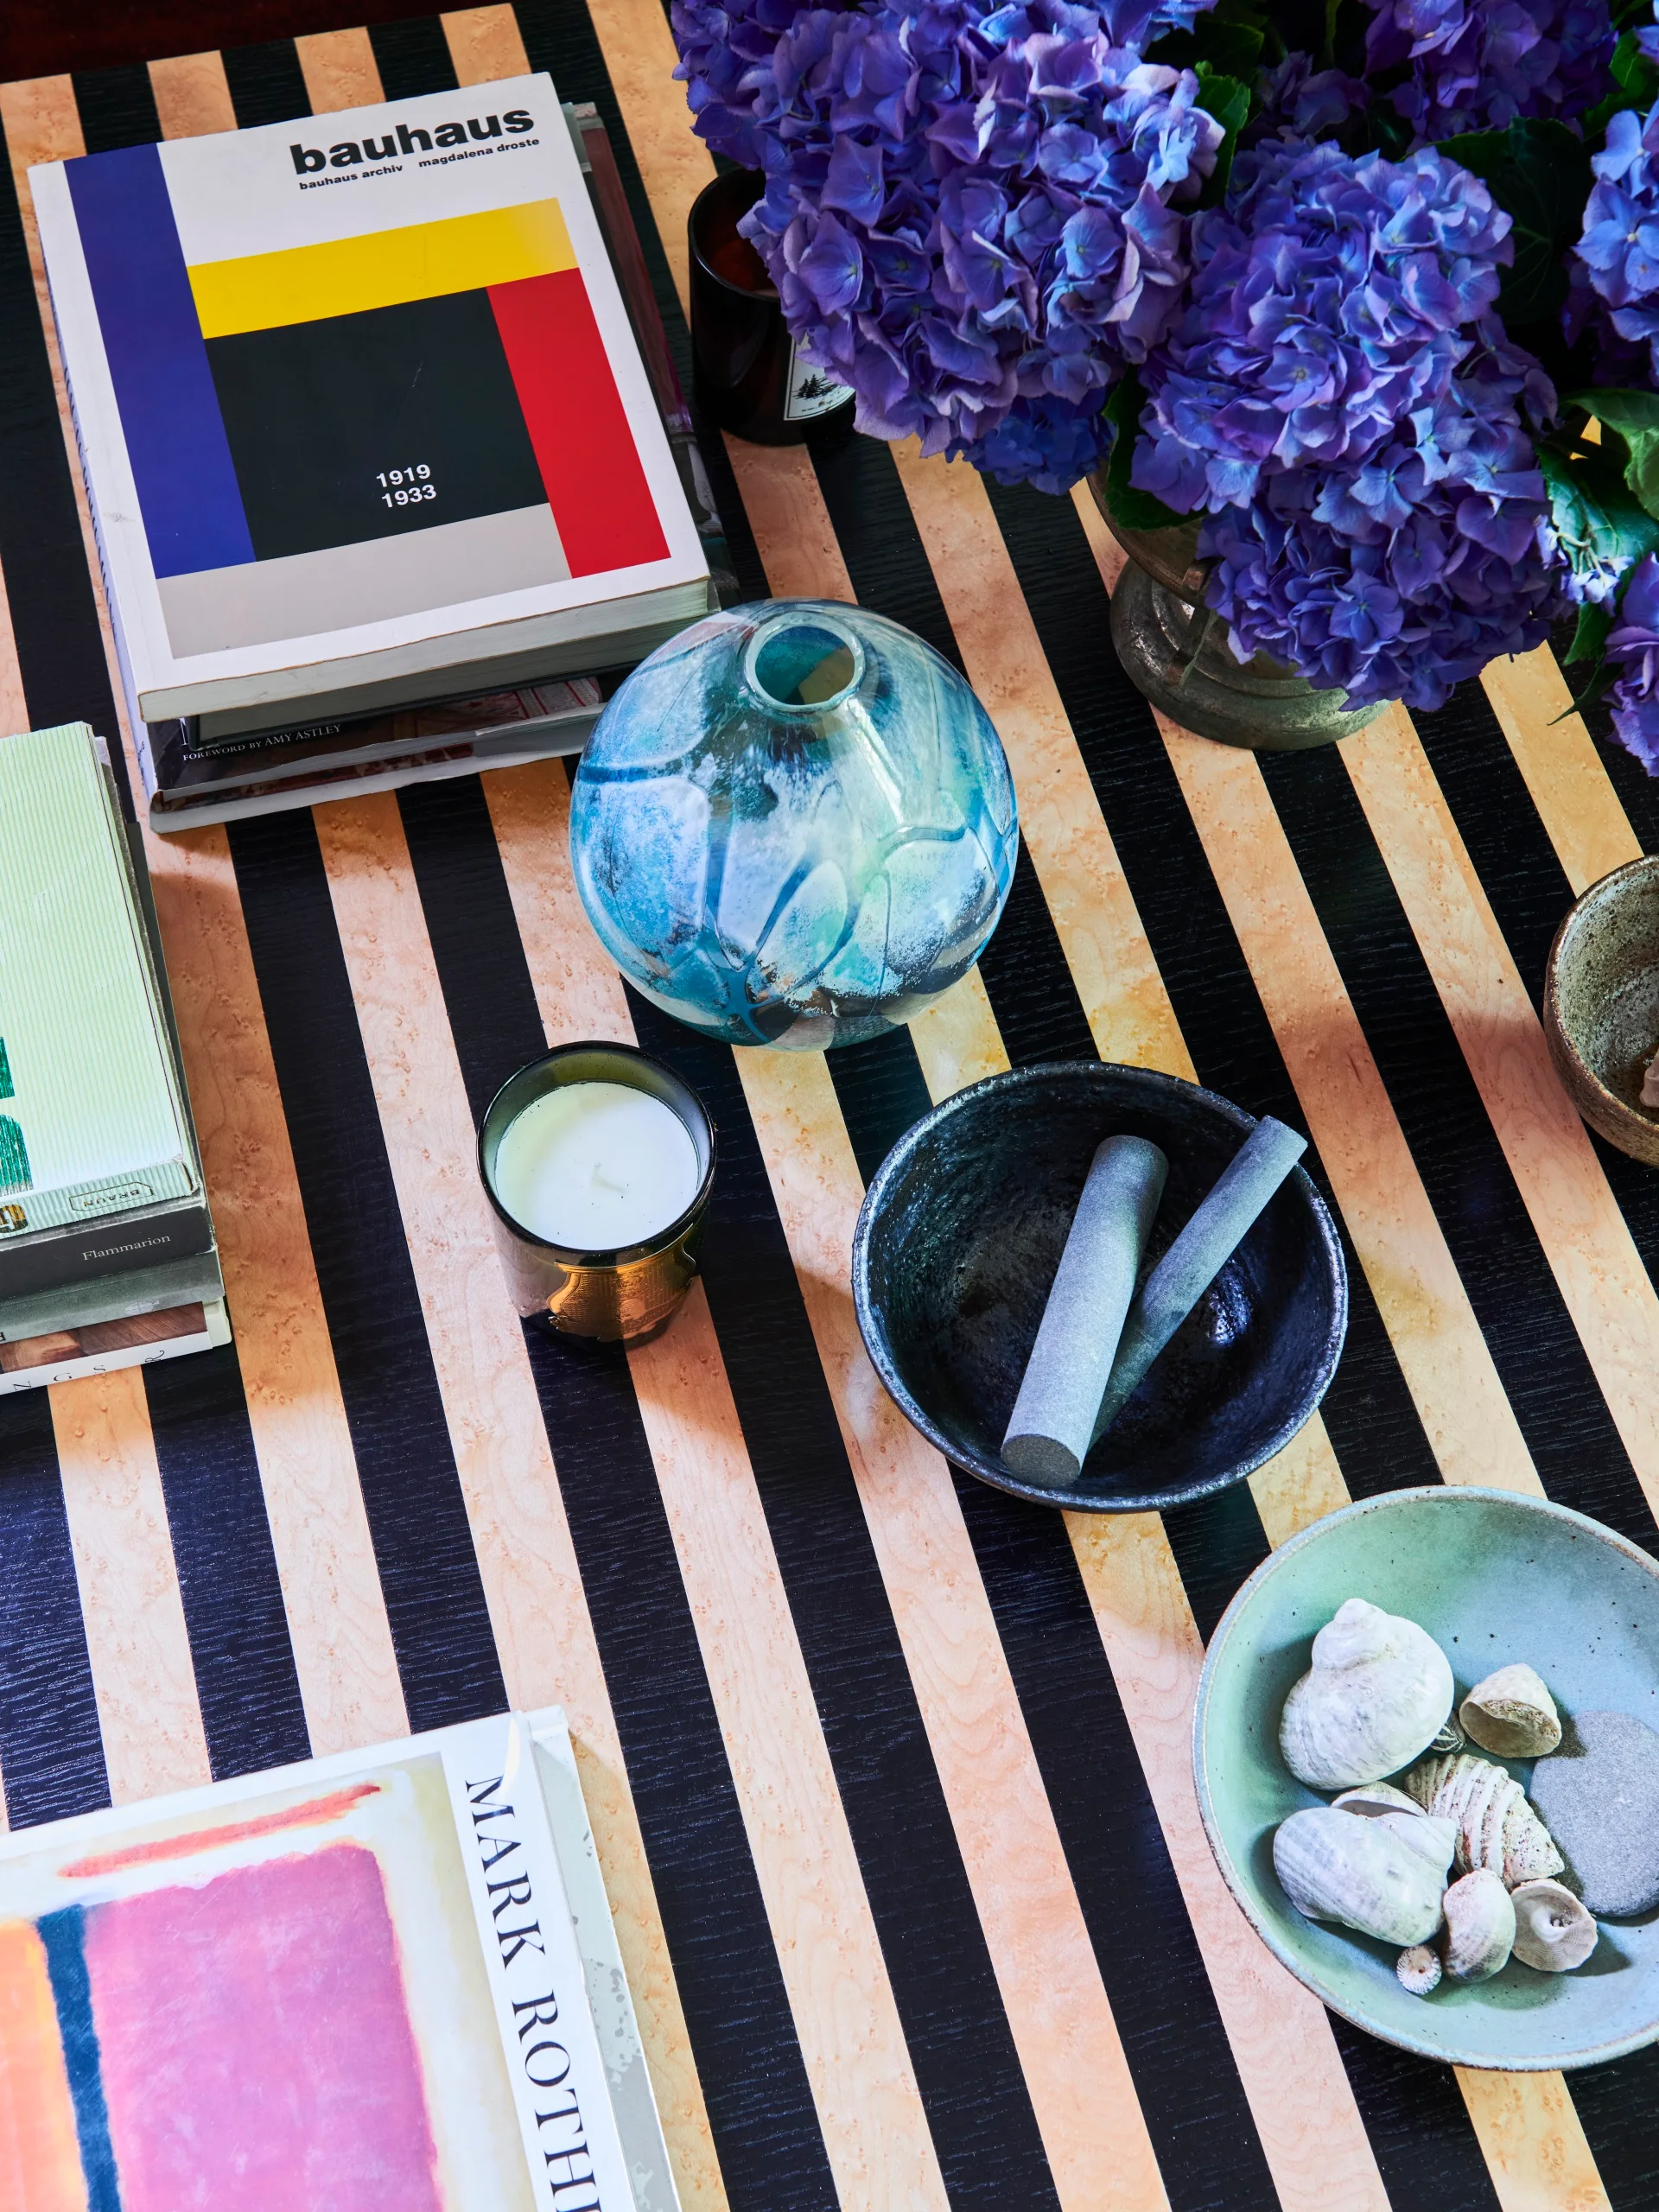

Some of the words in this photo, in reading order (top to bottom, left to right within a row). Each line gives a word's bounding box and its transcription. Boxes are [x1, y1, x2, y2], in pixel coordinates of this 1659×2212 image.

[289, 110, 534, 175] bauhaus
[299, 172, 358, 190] bauhaus
[361, 163, 404, 179] archiv
[418, 145, 493, 168] magdalena
[497, 138, 540, 153] droste
[376, 464, 431, 487] 1919
[381, 484, 437, 508] 1933
[182, 744, 245, 761] FOREWORD
[249, 741, 263, 750] BY
[264, 733, 293, 747] AMY
[296, 724, 341, 741] ASTLEY
[83, 1189, 140, 1207] BRAUN
[82, 1235, 171, 1261] Flammarion
[465, 1770, 546, 1971] MARK
